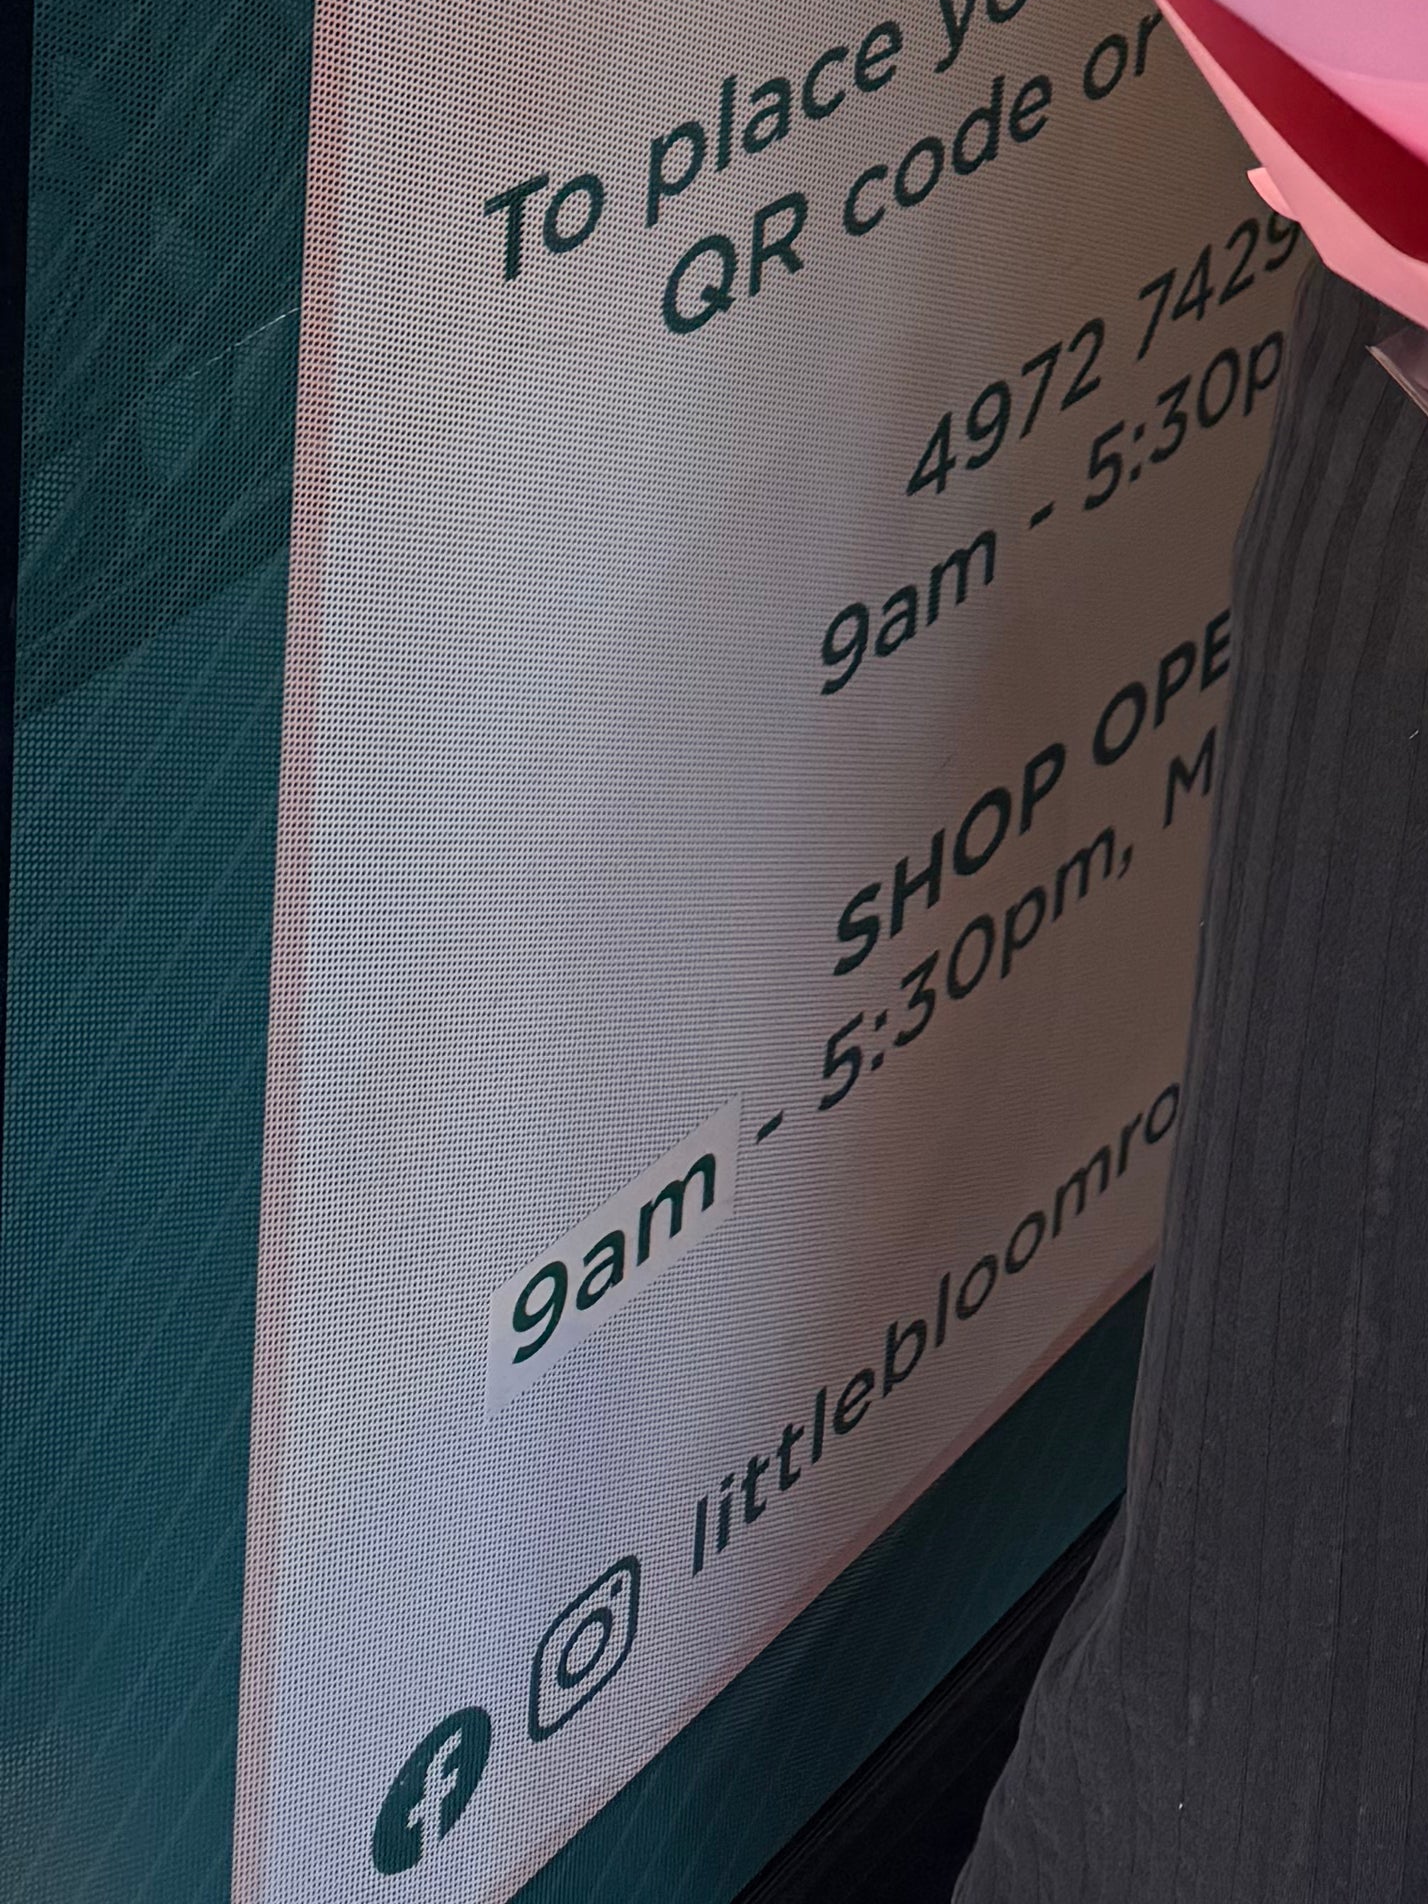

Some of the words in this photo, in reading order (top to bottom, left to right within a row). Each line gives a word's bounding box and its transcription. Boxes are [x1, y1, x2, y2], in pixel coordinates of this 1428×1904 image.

[484, 172, 603, 282] To
[645, 14, 904, 228] place
[661, 198, 807, 335] QR
[843, 75, 1053, 239] code
[1082, 10, 1163, 101] or
[906, 316, 1106, 497] 4972
[1137, 212, 1301, 362] 7429
[820, 529, 997, 696] 9am
[832, 742, 1067, 977] SHOP
[509, 1152, 717, 1365] 9am
[817, 825, 1134, 1112] 5:30pm,
